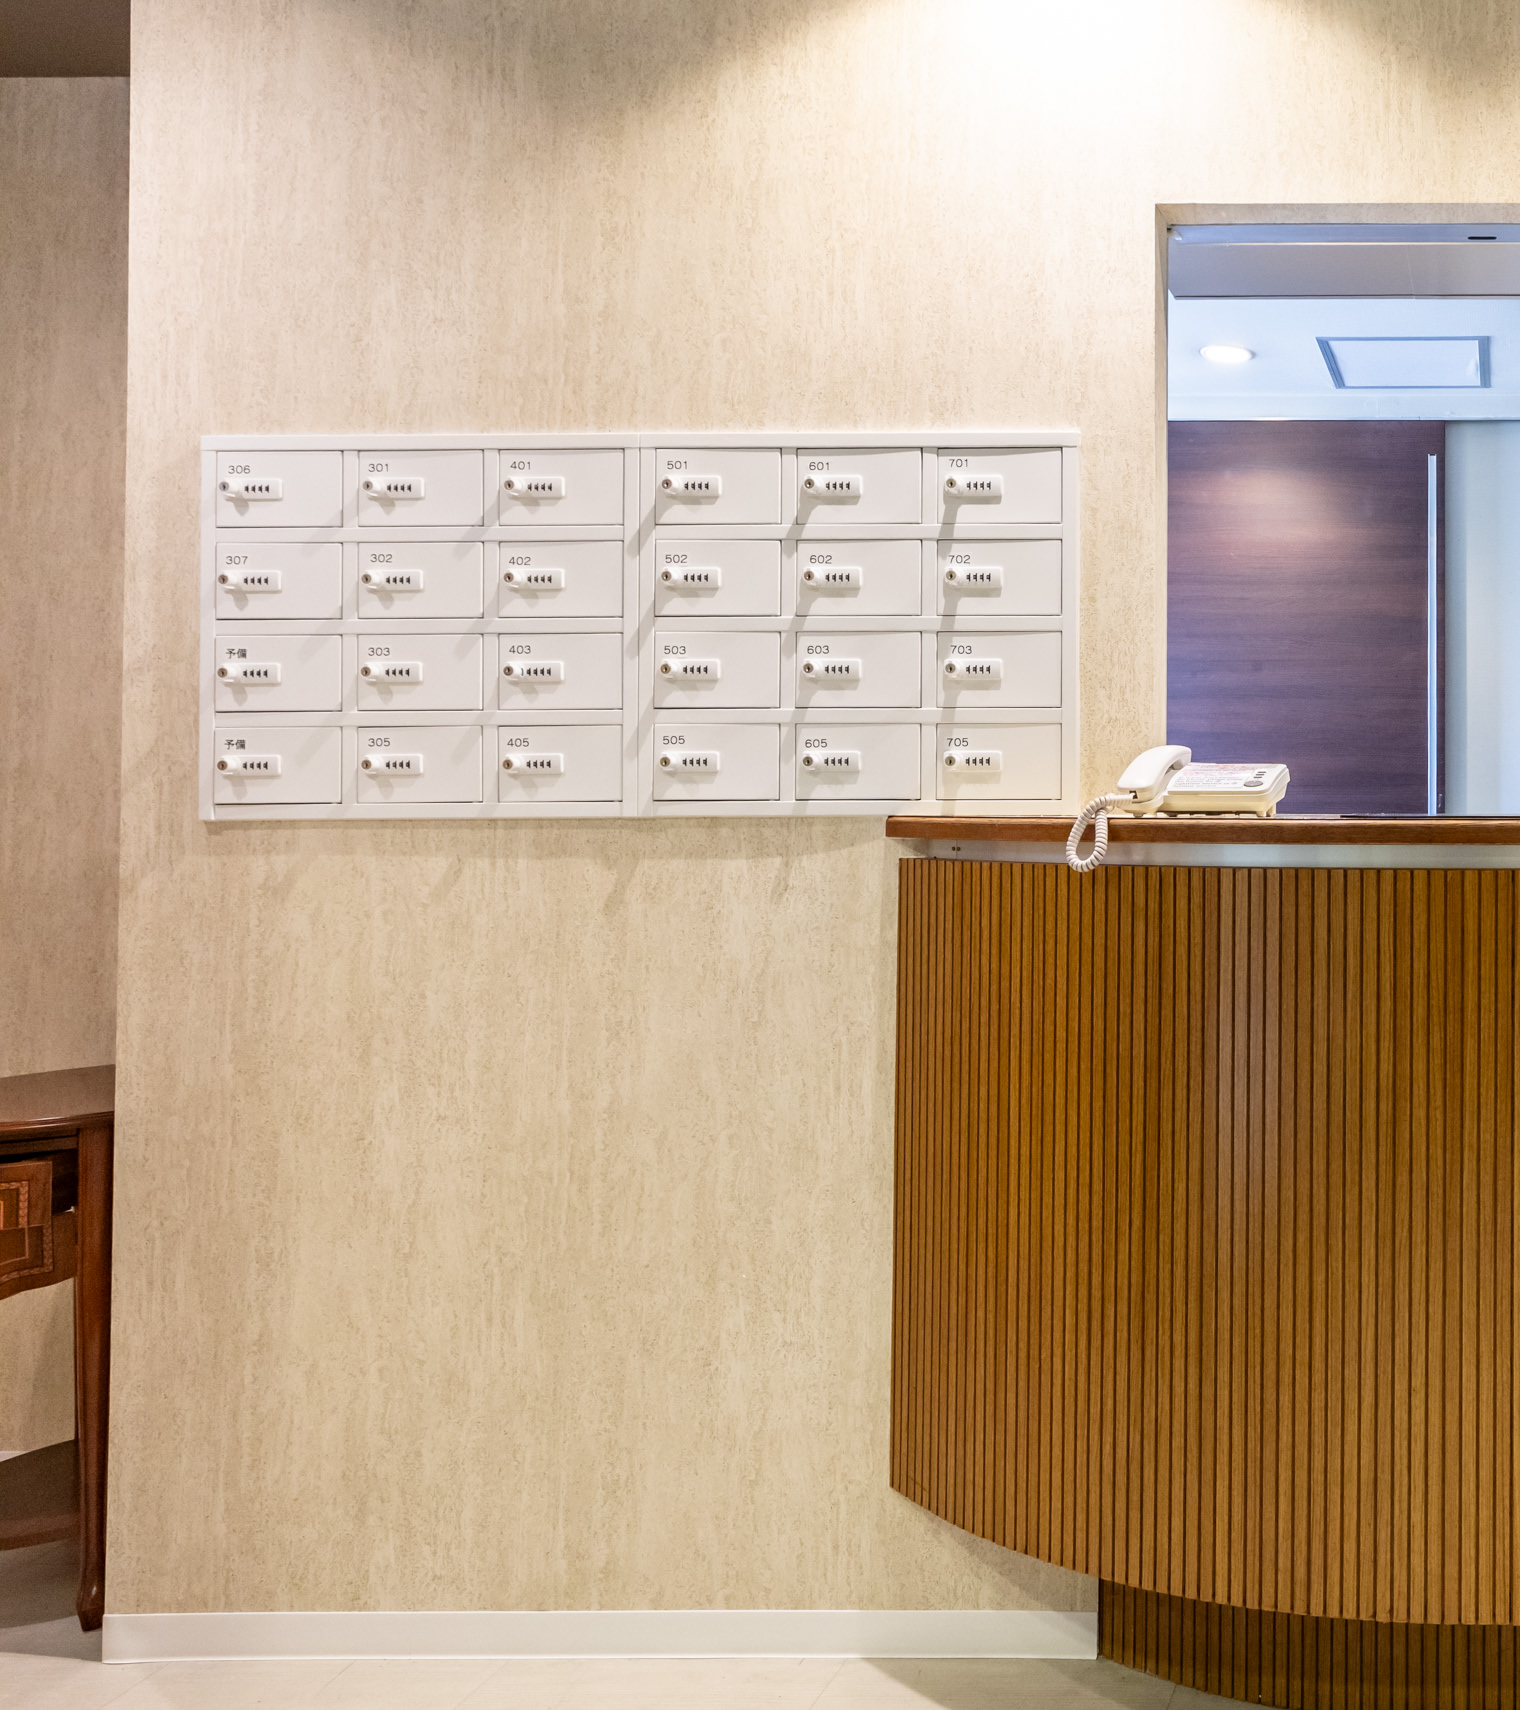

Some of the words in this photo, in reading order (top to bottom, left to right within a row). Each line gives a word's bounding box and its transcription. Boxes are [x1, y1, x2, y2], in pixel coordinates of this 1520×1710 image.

[369, 463, 388, 472] 301
[510, 461, 530, 470] 401
[667, 461, 687, 469] 501
[809, 462, 829, 470] 601
[949, 459, 969, 467] 701
[229, 465, 250, 474] 306
[226, 556, 248, 564] 307
[371, 554, 392, 563] 302
[509, 557, 531, 565] 402
[665, 555, 687, 563] 502
[810, 555, 832, 564] 602
[948, 555, 970, 564] 702
[226, 649, 246, 658] 予備
[368, 647, 390, 656] 303
[509, 645, 531, 654] 403
[664, 646, 686, 654] 503
[807, 645, 829, 654] 603
[951, 645, 972, 654] 703
[225, 740, 245, 750] 予備
[368, 738, 390, 747] 305
[507, 738, 529, 747] 405
[663, 736, 685, 745] 505
[805, 739, 827, 748] 605
[947, 738, 968, 747] 705
